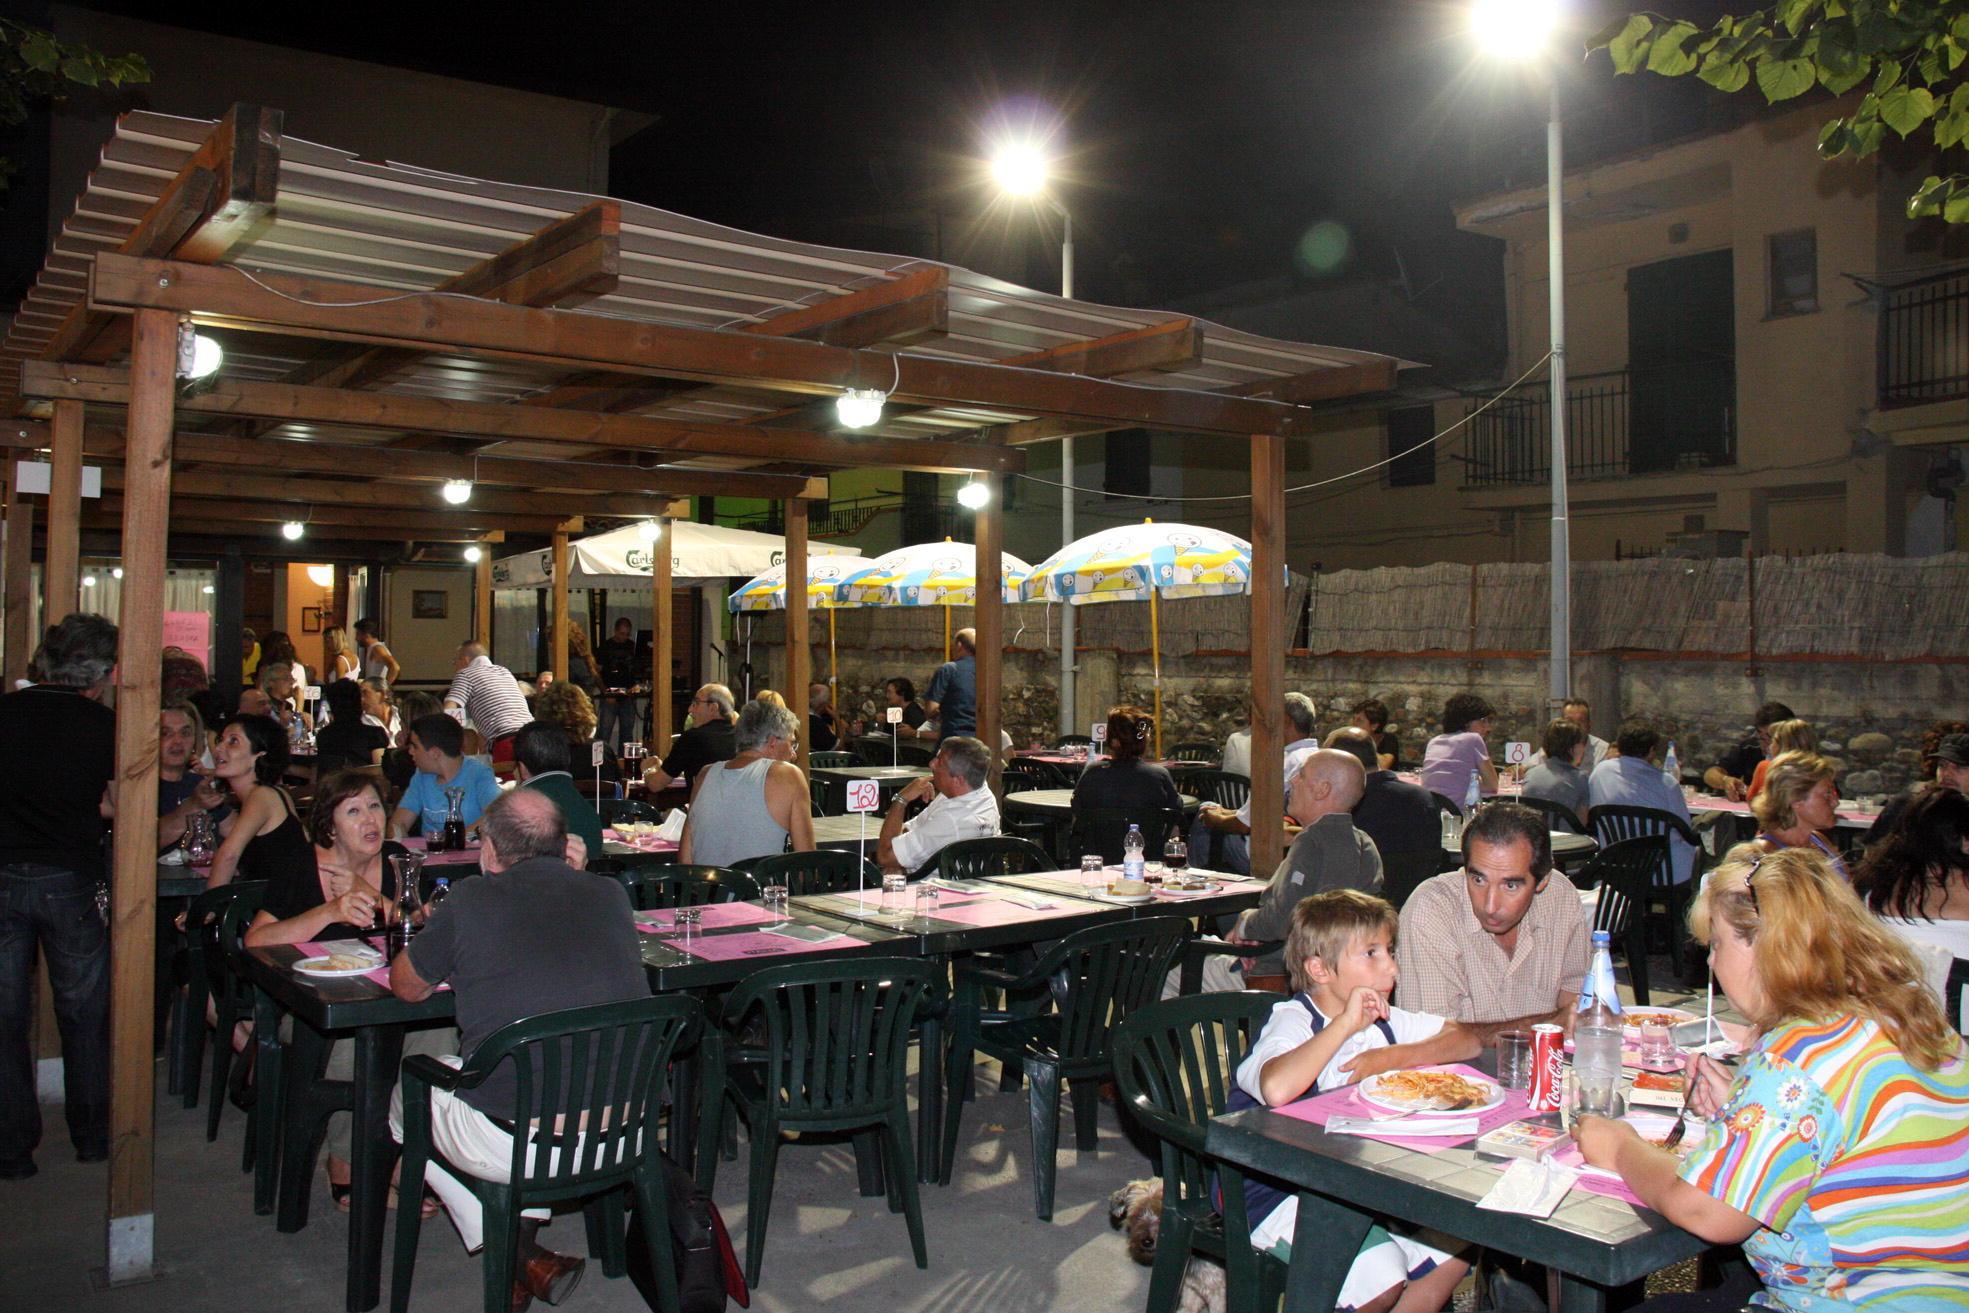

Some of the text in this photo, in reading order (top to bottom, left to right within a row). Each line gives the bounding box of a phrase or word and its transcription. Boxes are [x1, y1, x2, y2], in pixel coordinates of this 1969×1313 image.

[626, 550, 680, 571] Carlsg
[888, 709, 902, 722] 10
[1096, 725, 1106, 740] 9
[1511, 743, 1525, 762] 8
[849, 783, 879, 809] 12
